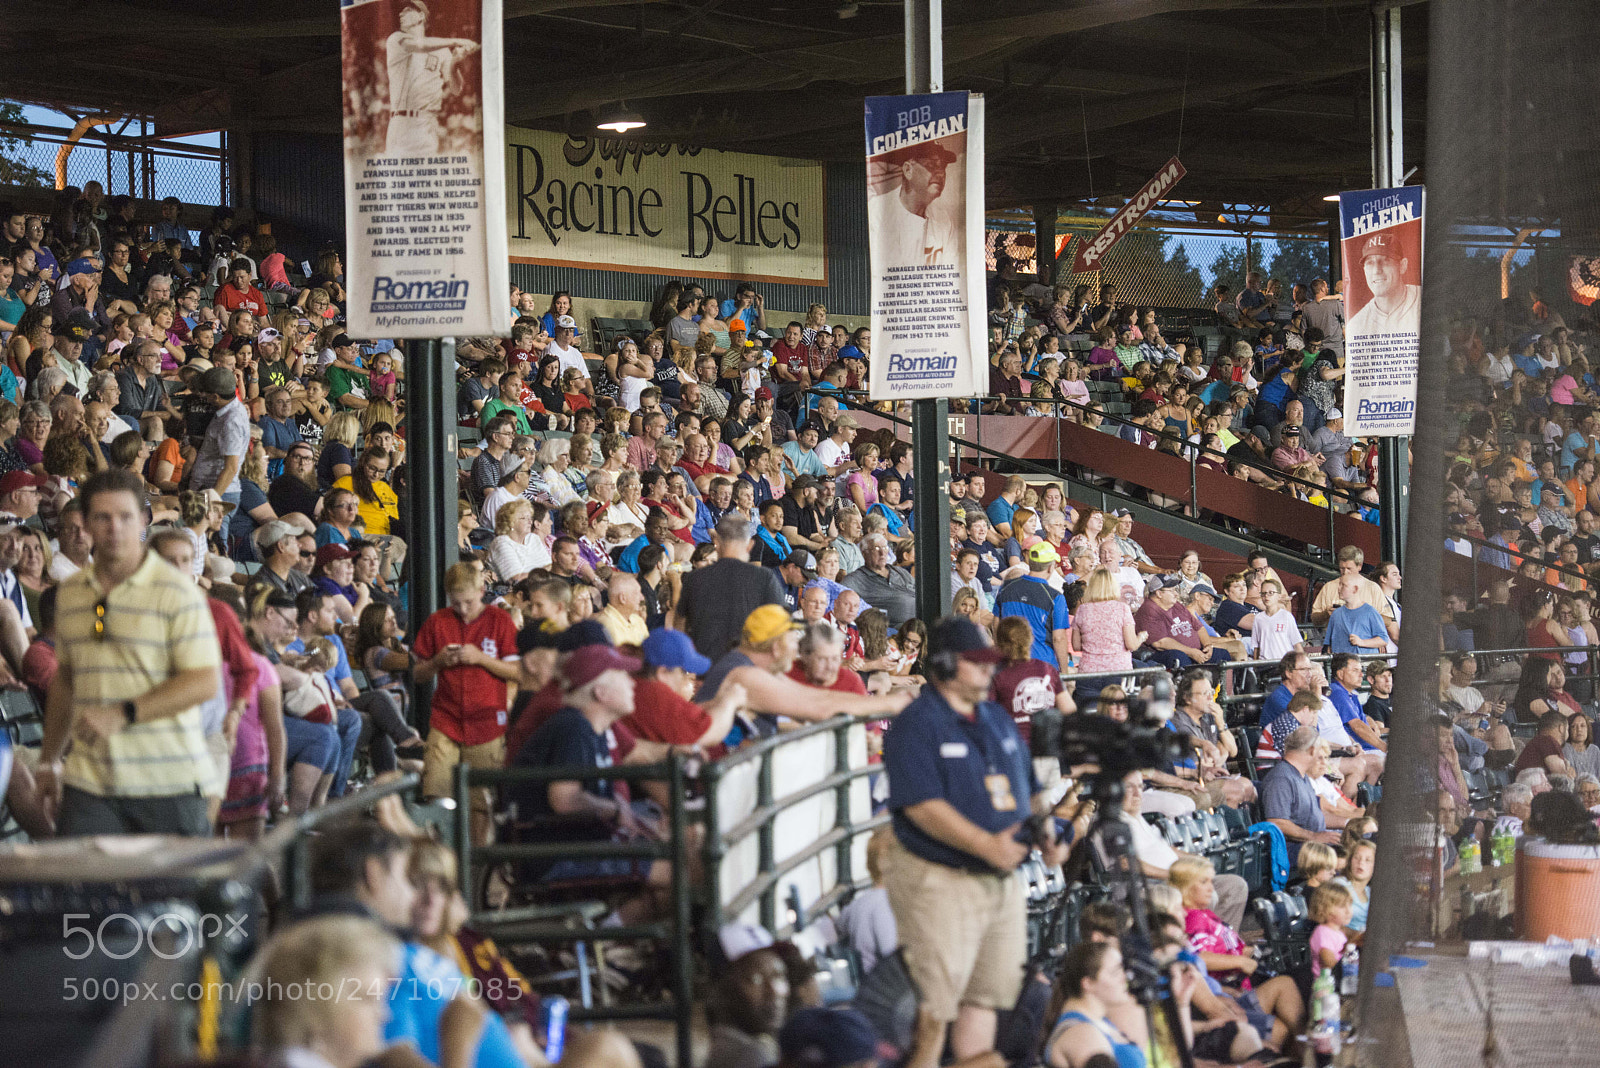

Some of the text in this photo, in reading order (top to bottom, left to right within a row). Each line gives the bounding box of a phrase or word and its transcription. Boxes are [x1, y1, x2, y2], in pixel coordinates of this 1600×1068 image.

[897, 105, 931, 129] BOB
[873, 114, 964, 155] COLEMAN
[355, 181, 386, 190] BATTED
[445, 178, 481, 186] DOUBLES
[509, 144, 800, 258] Racine Belles
[1363, 194, 1400, 214] CHUCK
[1083, 164, 1178, 266] RESTROOM
[1352, 202, 1413, 237] KLEIN
[1369, 236, 1385, 247] NL
[372, 274, 469, 300] Romain
[376, 316, 463, 328] MyRomain.com
[889, 352, 957, 371] Romain
[891, 383, 953, 391] MyRomain.com
[1358, 397, 1414, 413] Romain
